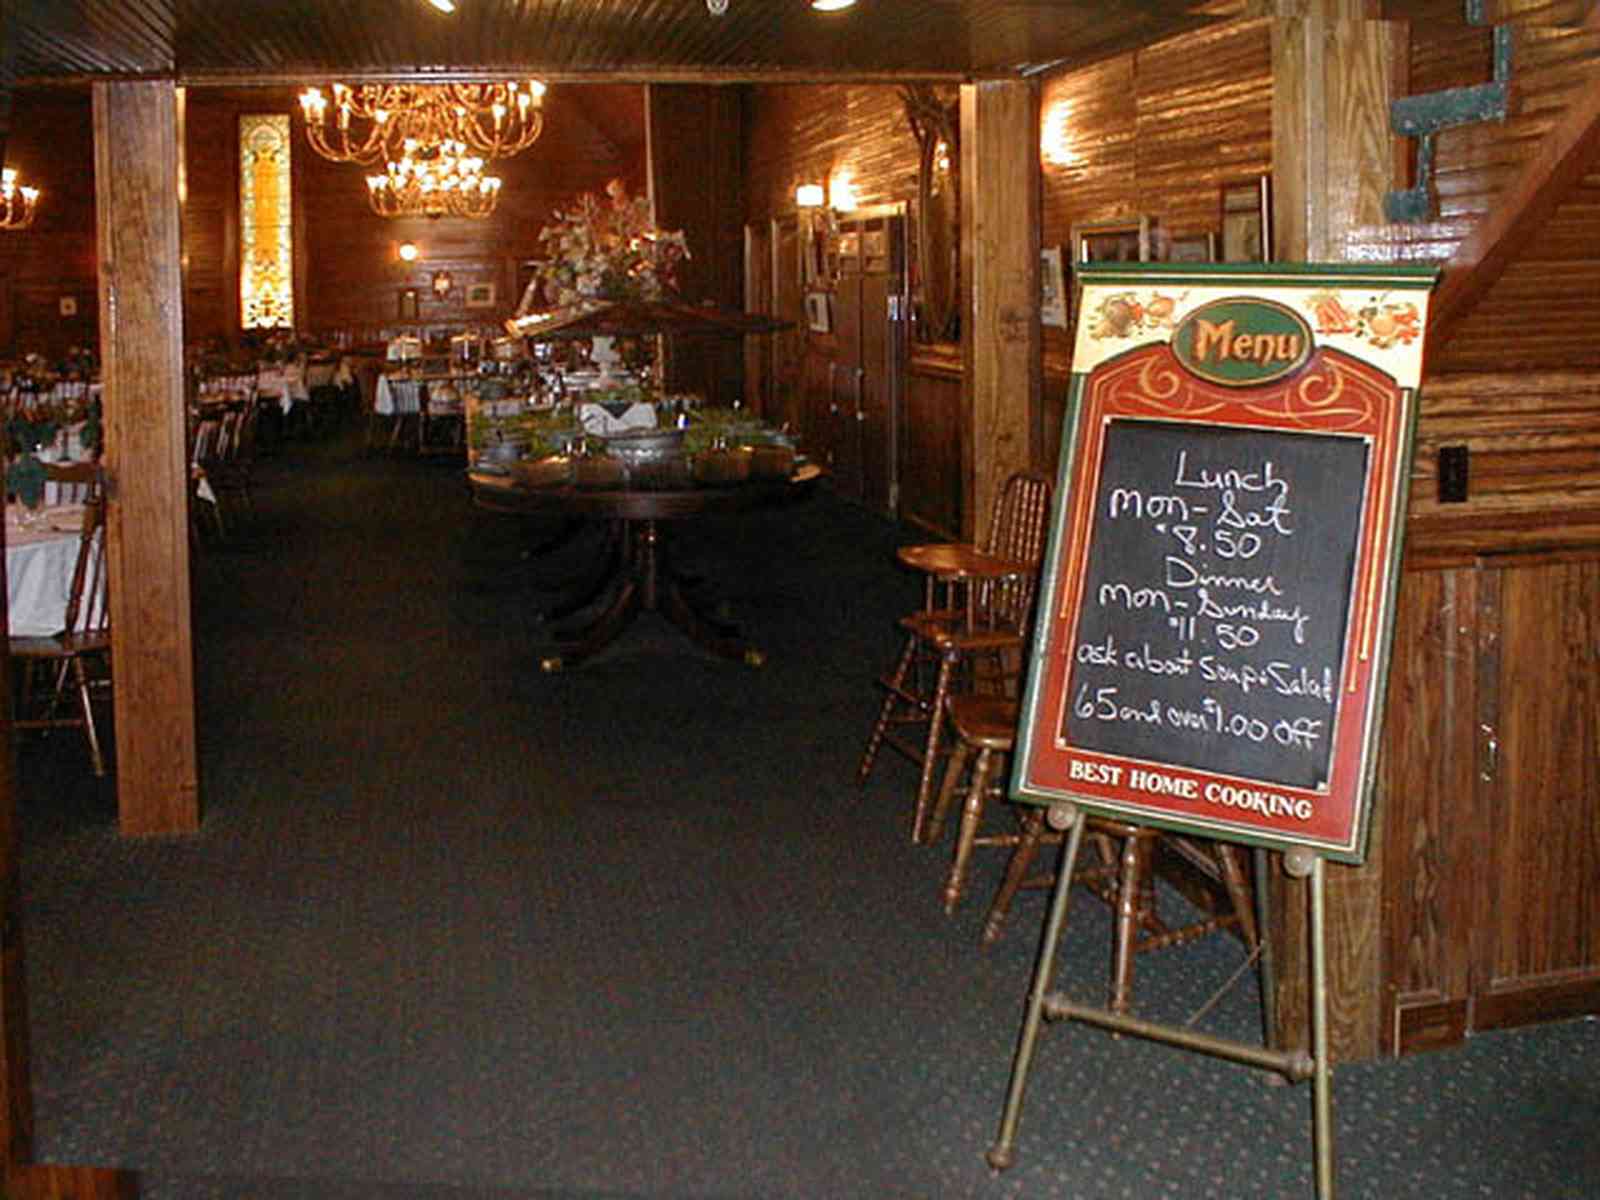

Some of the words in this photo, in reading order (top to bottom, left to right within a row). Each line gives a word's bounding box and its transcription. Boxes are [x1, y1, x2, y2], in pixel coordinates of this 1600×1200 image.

[1193, 319, 1299, 366] Menu
[1175, 451, 1289, 496] Lunch
[1217, 490, 1293, 536] Sat
[1166, 556, 1283, 596] Dinner
[1197, 588, 1309, 645] Sunday
[1125, 642, 1194, 676] about
[1068, 758, 1124, 786] BEST
[1129, 773, 1199, 799] HOME
[1204, 783, 1313, 822] COOKING
